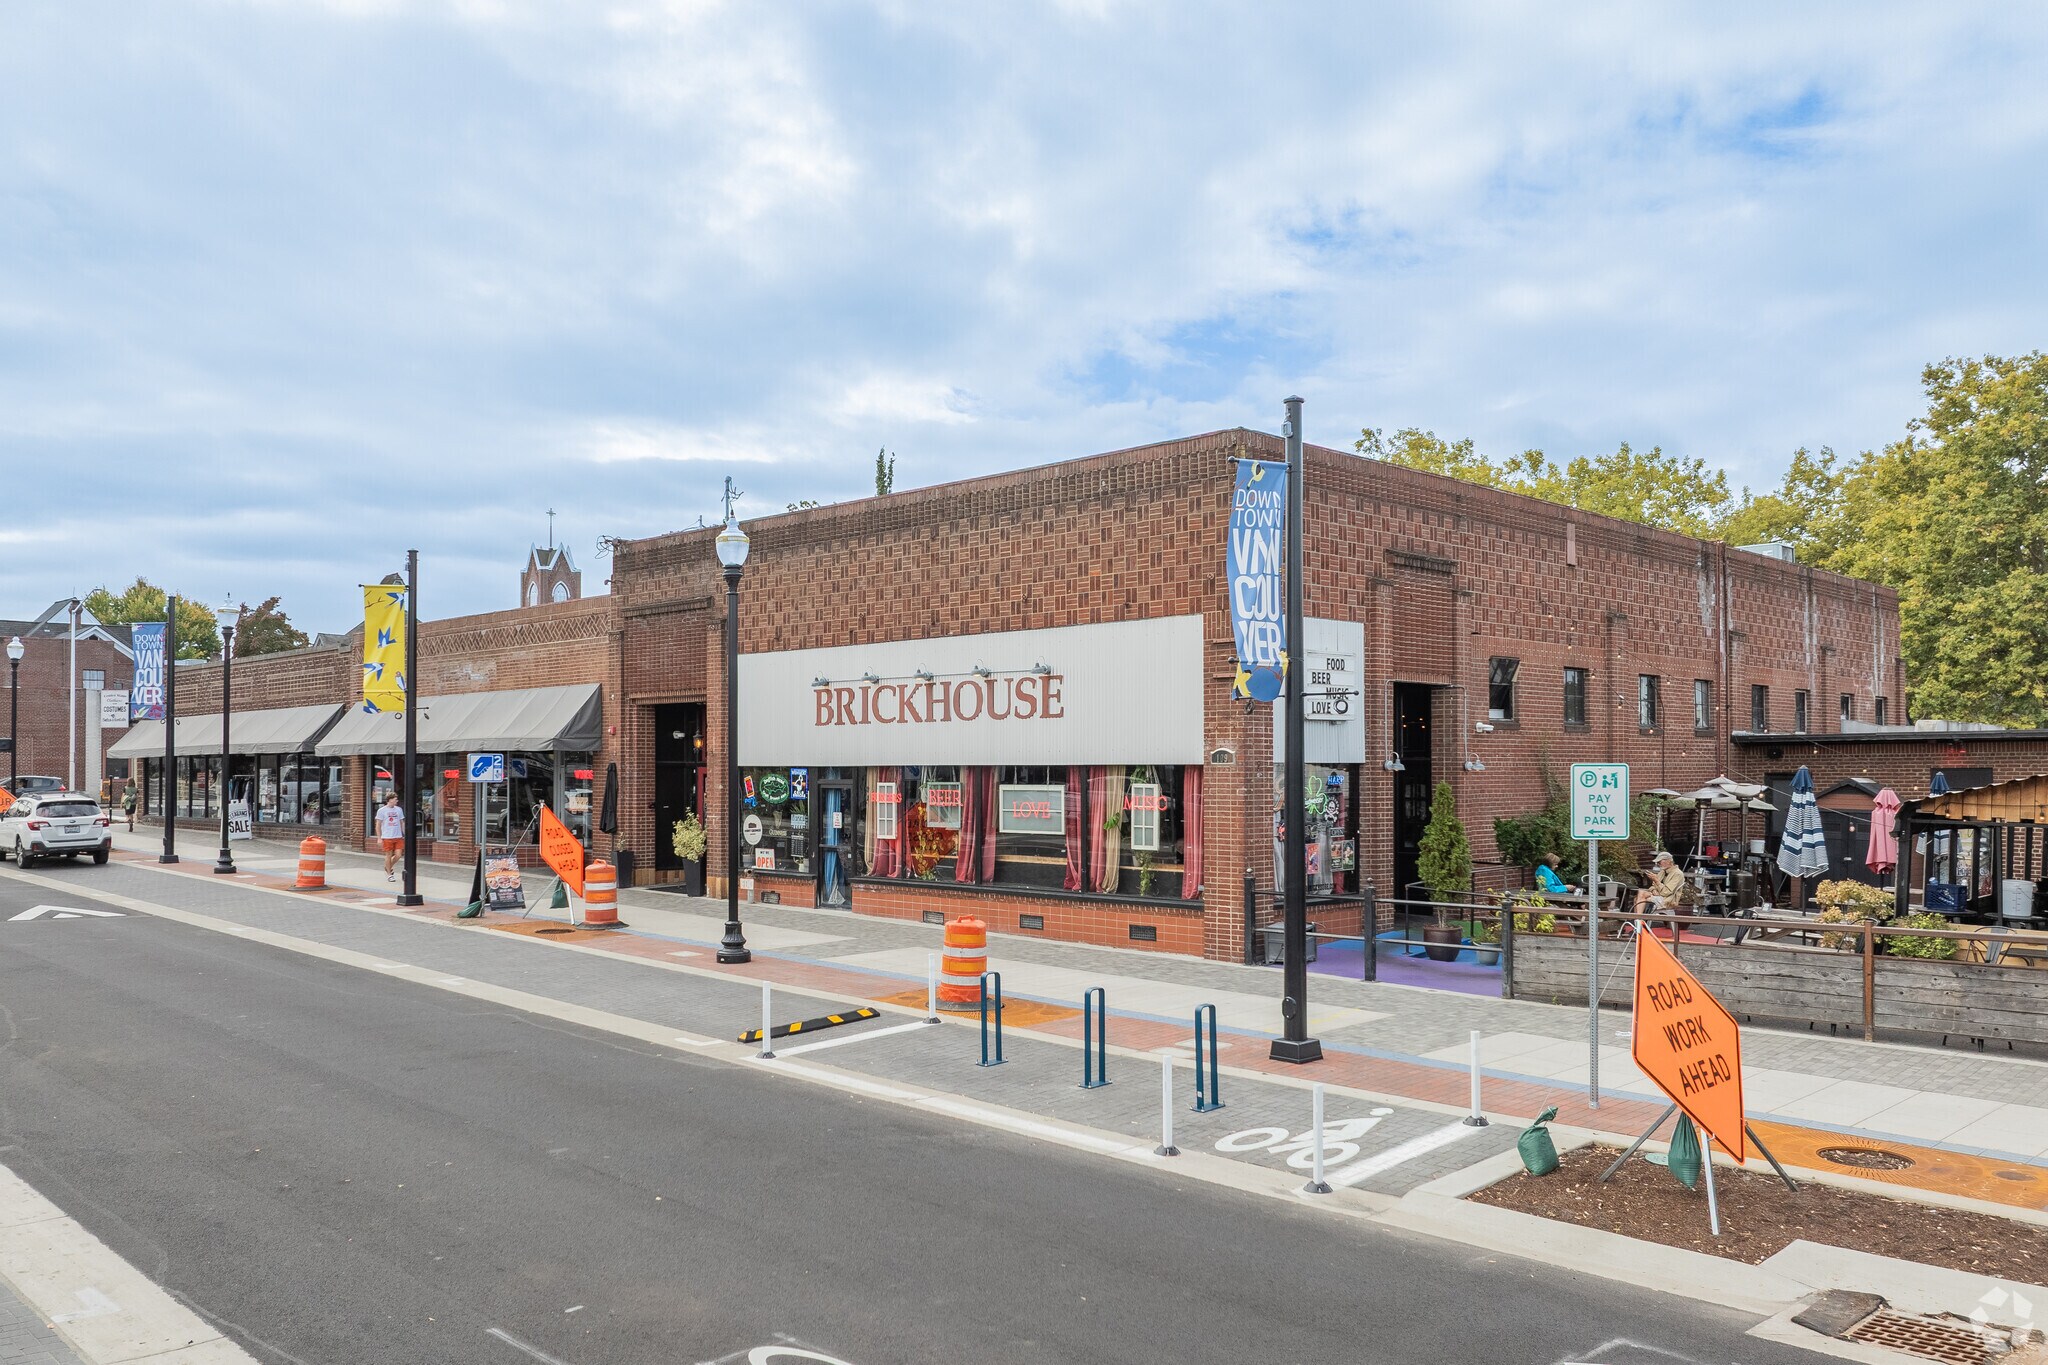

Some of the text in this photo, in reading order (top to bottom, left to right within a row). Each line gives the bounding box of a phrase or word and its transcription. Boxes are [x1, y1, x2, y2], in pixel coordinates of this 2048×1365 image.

[1235, 508, 1281, 528] TOWN
[1234, 574, 1280, 622] COU
[134, 634, 164, 642] DOWN
[1237, 620, 1283, 667] VER
[135, 642, 164, 650] TOWN
[135, 650, 163, 669] VAN
[1326, 657, 1346, 671] FOOD
[135, 668, 163, 687] COU
[1311, 671, 1331, 685] BEER
[131, 687, 164, 705] VER
[813, 674, 1065, 727] BRICKHOUSE
[1326, 687, 1349, 700] MUSIC
[1311, 701, 1332, 714] LOVE
[493, 755, 502, 766] 2
[928, 789, 963, 807] BEER
[1123, 795, 1168, 811] MUSIC
[1588, 794, 1611, 803] PAY
[1012, 801, 1052, 819] LOVE
[1592, 805, 1608, 814] TO
[228, 820, 250, 833] SALE
[1584, 816, 1616, 825] PARK
[545, 827, 564, 839] ROAD
[549, 842, 574, 856] CLOSED
[557, 859, 579, 871] AHEAD
[757, 856, 774, 868] OPEN
[1646, 977, 1693, 1012] ROAD
[1662, 1015, 1712, 1053] WORK
[1678, 1053, 1731, 1098] AHEAD
